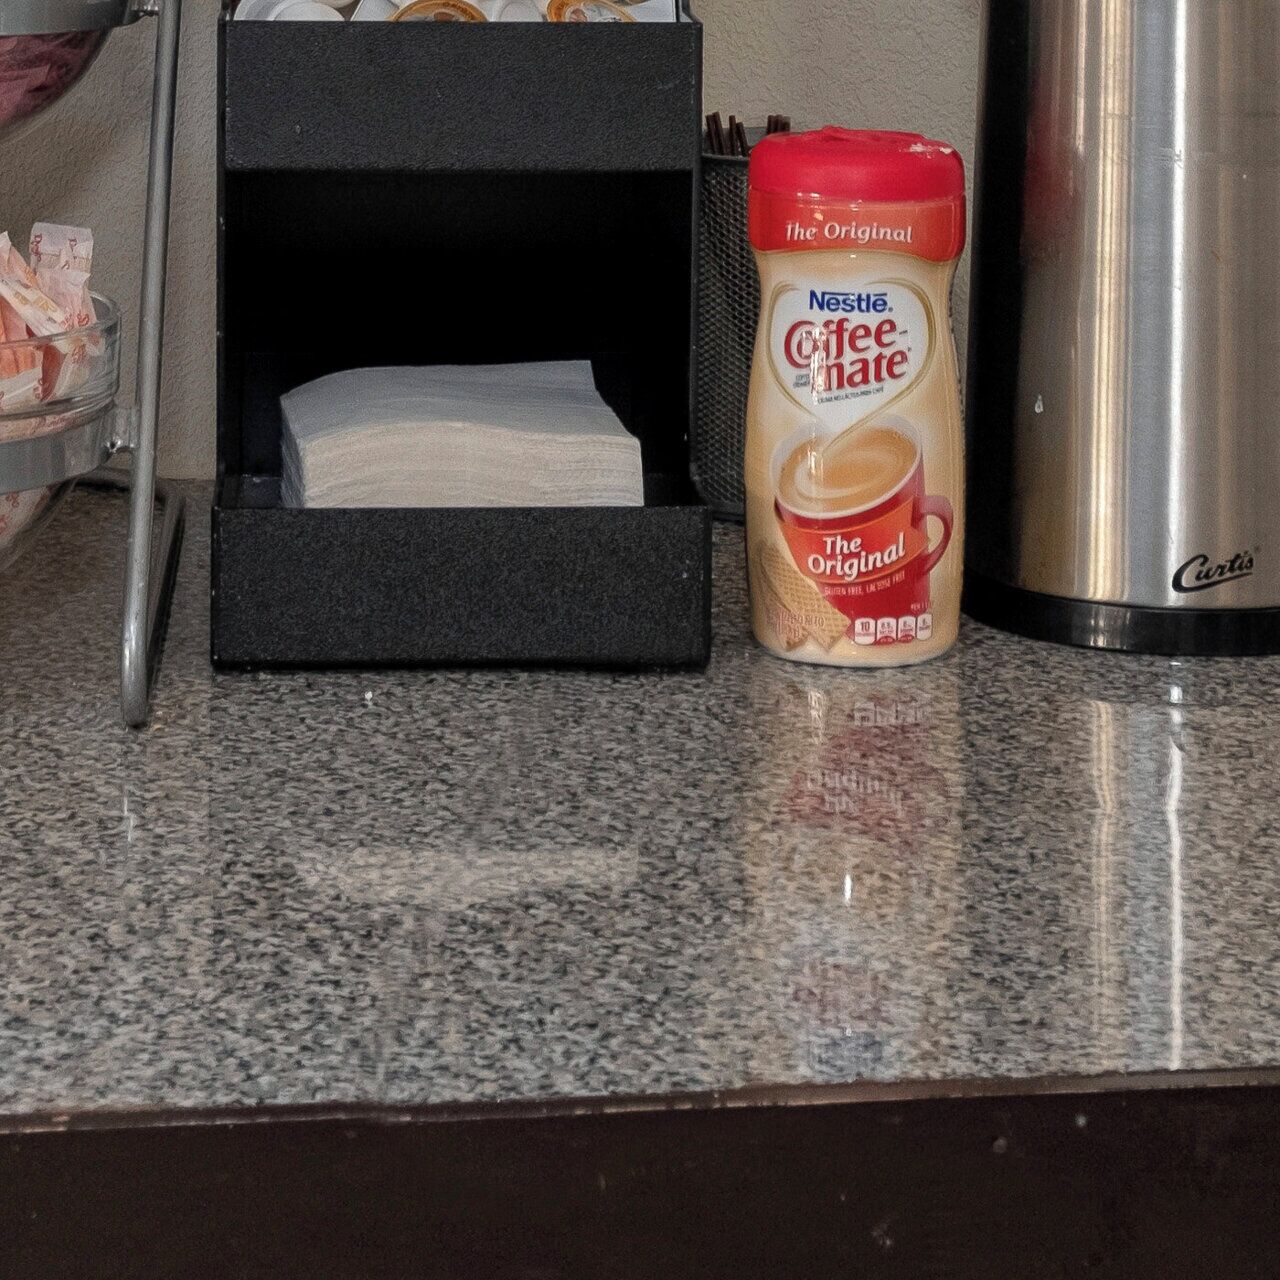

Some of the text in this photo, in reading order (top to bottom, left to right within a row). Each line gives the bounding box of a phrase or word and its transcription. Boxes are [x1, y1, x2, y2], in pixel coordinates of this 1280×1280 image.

[786, 221, 913, 244] The Original
[807, 531, 906, 581] Original
[823, 535, 862, 555] The
[1172, 550, 1254, 594] Curtis
[859, 621, 870, 632] 10
